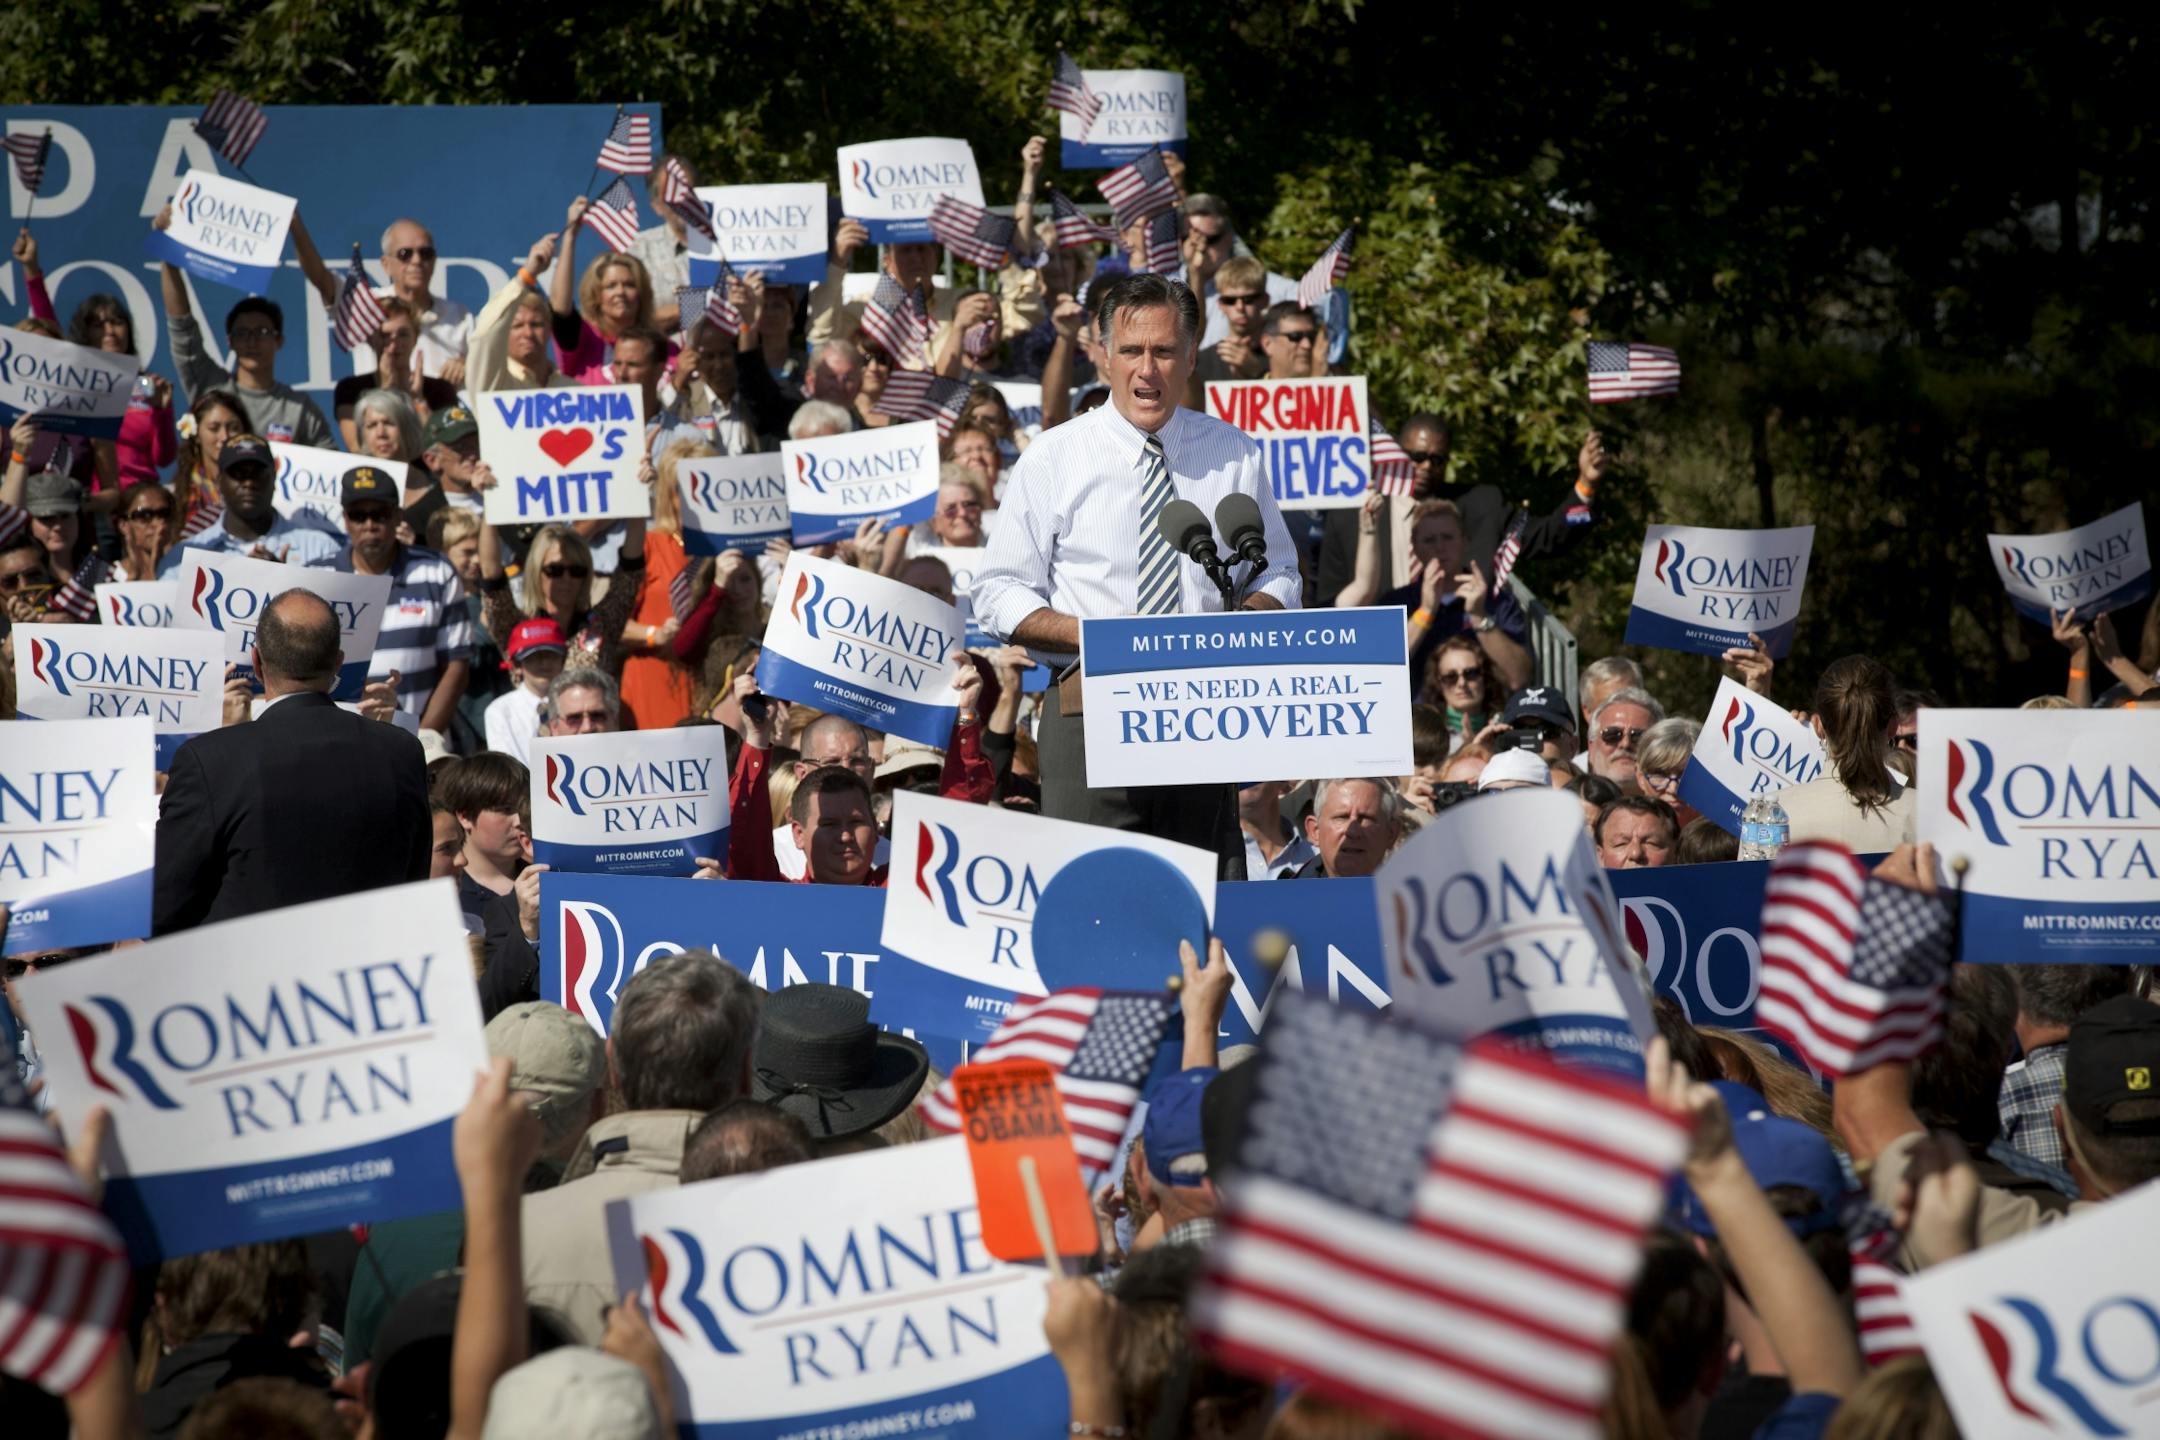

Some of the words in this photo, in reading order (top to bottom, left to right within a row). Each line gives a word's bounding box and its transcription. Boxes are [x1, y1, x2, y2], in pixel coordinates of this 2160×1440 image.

[1095, 91, 1178, 113] OMNEY
[1107, 118, 1170, 136] RYAN
[853, 159, 968, 199] ROMNEY
[892, 190, 955, 210] RYA
[179, 182, 280, 238] ROMNEY
[200, 225, 258, 256] RYAN
[732, 234, 798, 252] RYAN
[23, 385, 98, 413] RYAN
[493, 391, 635, 430] VIRGINIA
[1208, 384, 1361, 433] VIRGINIA
[274, 455, 337, 502] ROM
[795, 445, 926, 495] ROMNEY
[516, 471, 614, 517] MITT
[690, 470, 786, 514] ROMN
[841, 479, 913, 506] RYAN
[733, 503, 790, 526] RYA
[1654, 538, 1800, 597] ROMNEY
[2002, 528, 2135, 590] ROMNEY
[2051, 564, 2123, 602] RYAN
[790, 570, 954, 666] ROMNEY
[1699, 595, 1781, 621] RYAN
[1132, 628, 1358, 652] MITTROMNEY.COM
[31, 637, 209, 697] ROMNEY
[832, 639, 927, 692] RYAN
[88, 692, 183, 725] RYAN
[813, 680, 897, 715] MITTROMNEY.COM
[1136, 681, 1179, 702] WE
[1186, 678, 1260, 700] NEED
[1266, 677, 1283, 697] A
[1289, 674, 1360, 697] REAL
[1119, 700, 1379, 744] RECOVERY
[546, 753, 712, 816] ROMNEY
[603, 801, 699, 833] RYAN
[595, 847, 685, 864] MITTROMNEY.COM
[1394, 854, 1571, 988] ROM
[62, 953, 436, 1110] ROMNEY
[220, 1056, 414, 1139] RYAN
[969, 1111, 1067, 1143] OBAMA
[225, 1156, 395, 1204] MITTROMNEY.COM
[641, 1206, 992, 1355] ROMNE
[783, 1295, 1001, 1389] RYAN
